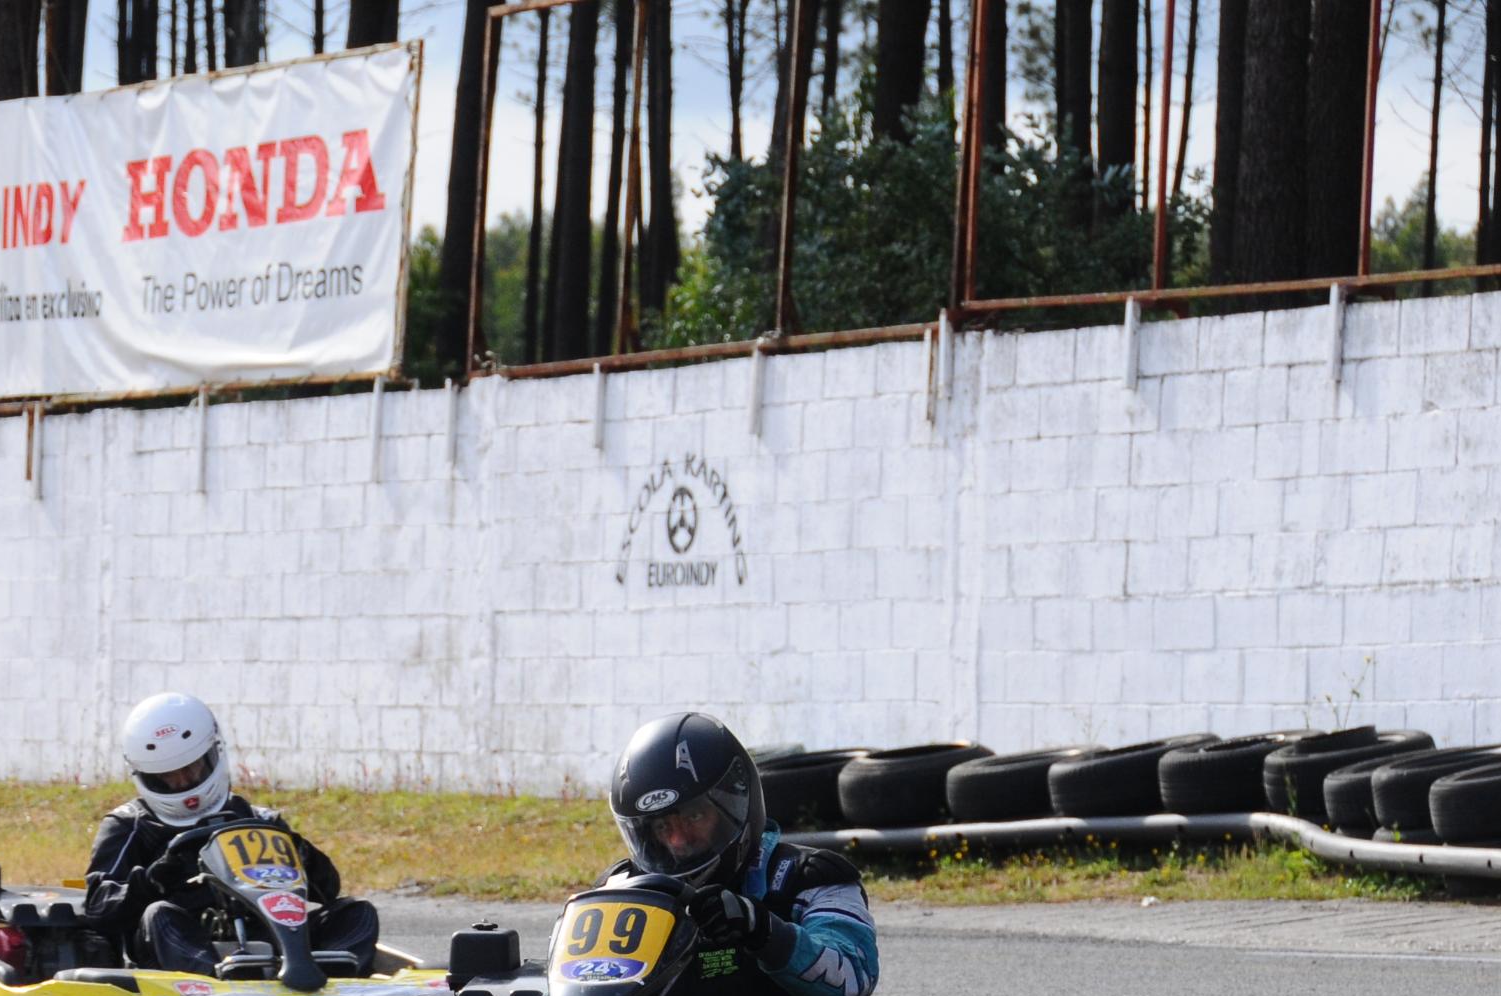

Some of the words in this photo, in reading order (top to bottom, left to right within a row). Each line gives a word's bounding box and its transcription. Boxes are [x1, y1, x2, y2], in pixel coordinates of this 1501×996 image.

[122, 128, 386, 243] HONDA
[141, 274, 176, 314] The
[182, 272, 247, 311] Power
[251, 263, 272, 305] of
[276, 261, 364, 303] Dreams
[648, 561, 718, 588] EUROINDY
[642, 790, 669, 807] CMS
[228, 830, 297, 869] 129
[567, 907, 648, 956] 99
